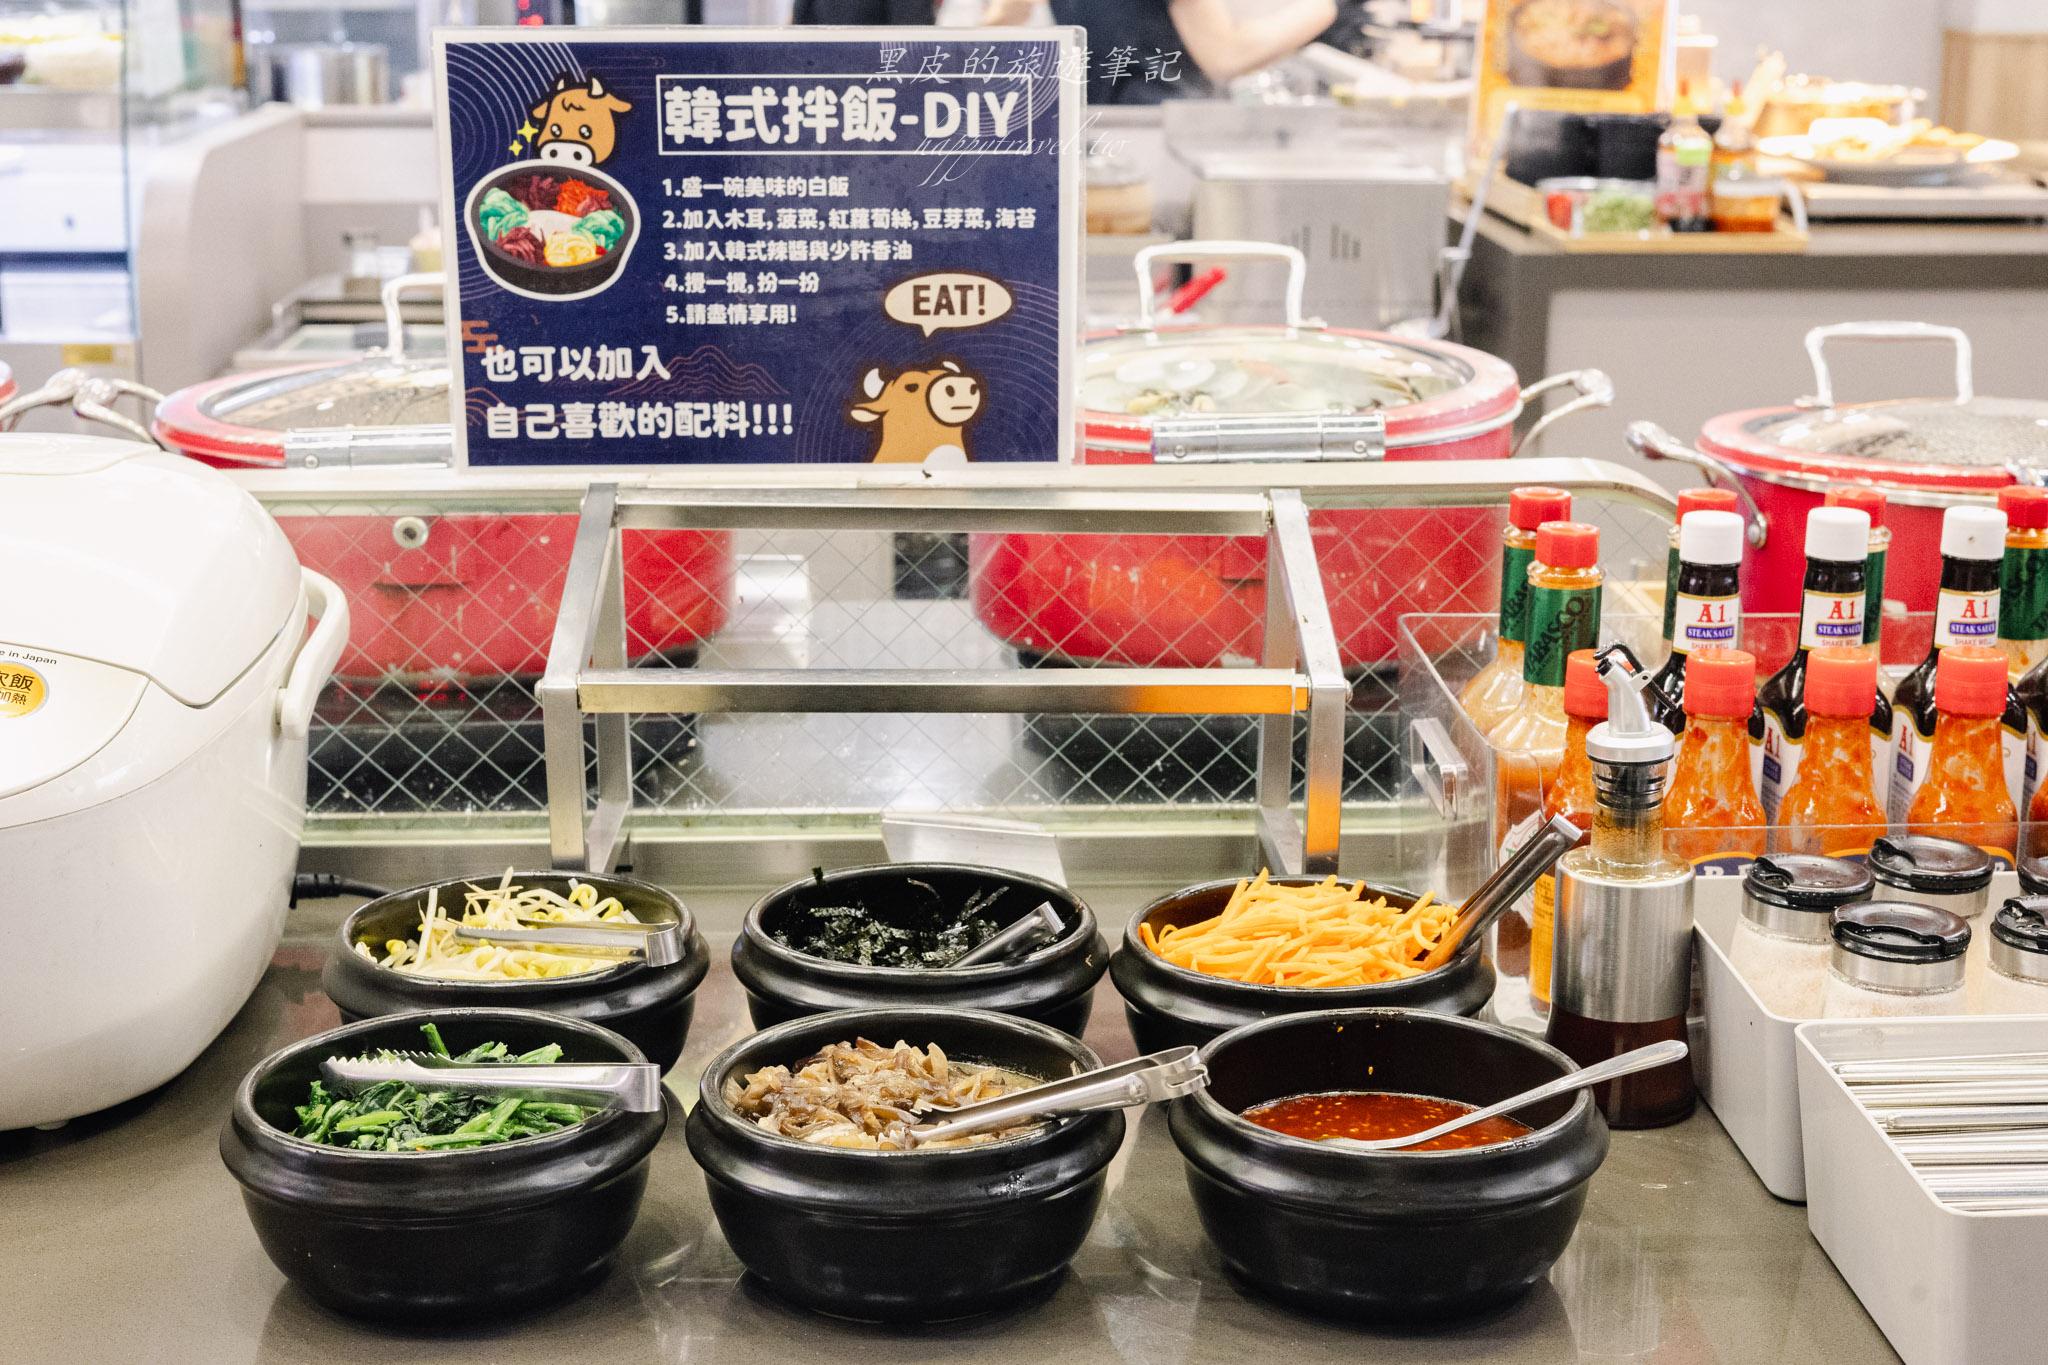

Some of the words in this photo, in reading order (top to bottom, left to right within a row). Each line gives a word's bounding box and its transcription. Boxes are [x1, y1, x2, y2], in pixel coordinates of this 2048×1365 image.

[663, 85, 1020, 145] 韓式拌飯-DIY
[912, 284, 986, 316] EAT!
[480, 344, 672, 383] 也可以加入
[486, 401, 793, 439] 自己喜歡的配料!!!
[1687, 627, 1712, 638] STEAK
[1817, 625, 1843, 635] STEAK
[1950, 623, 1975, 634] STEAK
[22, 653, 57, 665] Japan
